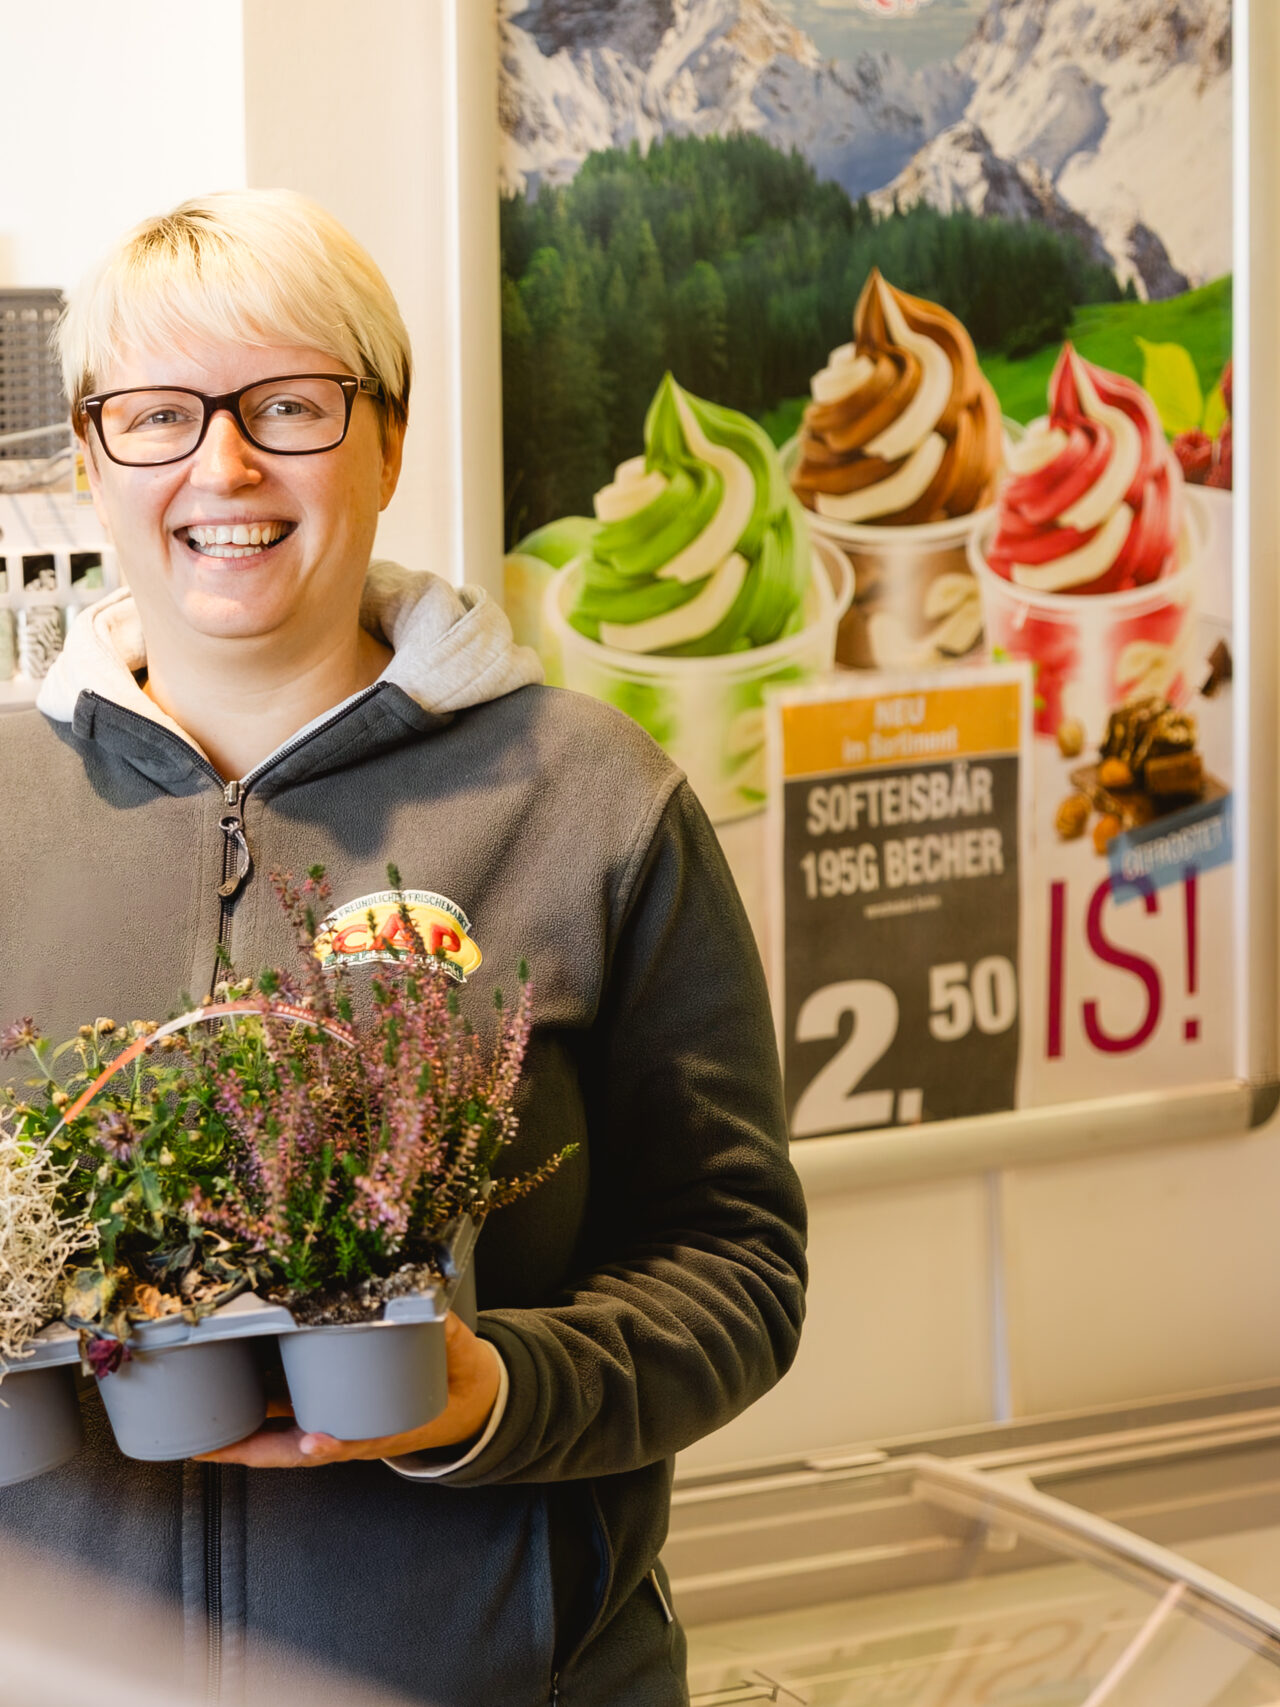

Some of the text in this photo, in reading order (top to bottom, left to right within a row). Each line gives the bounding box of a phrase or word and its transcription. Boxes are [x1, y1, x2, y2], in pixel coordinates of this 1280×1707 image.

[873, 695, 927, 729] NEU
[869, 724, 959, 760] Sortiment
[806, 760, 994, 837] SOFTEISBÄR
[800, 827, 1004, 899] 195G BECHER
[331, 913, 462, 955] CAP
[928, 954, 1018, 1042] 50
